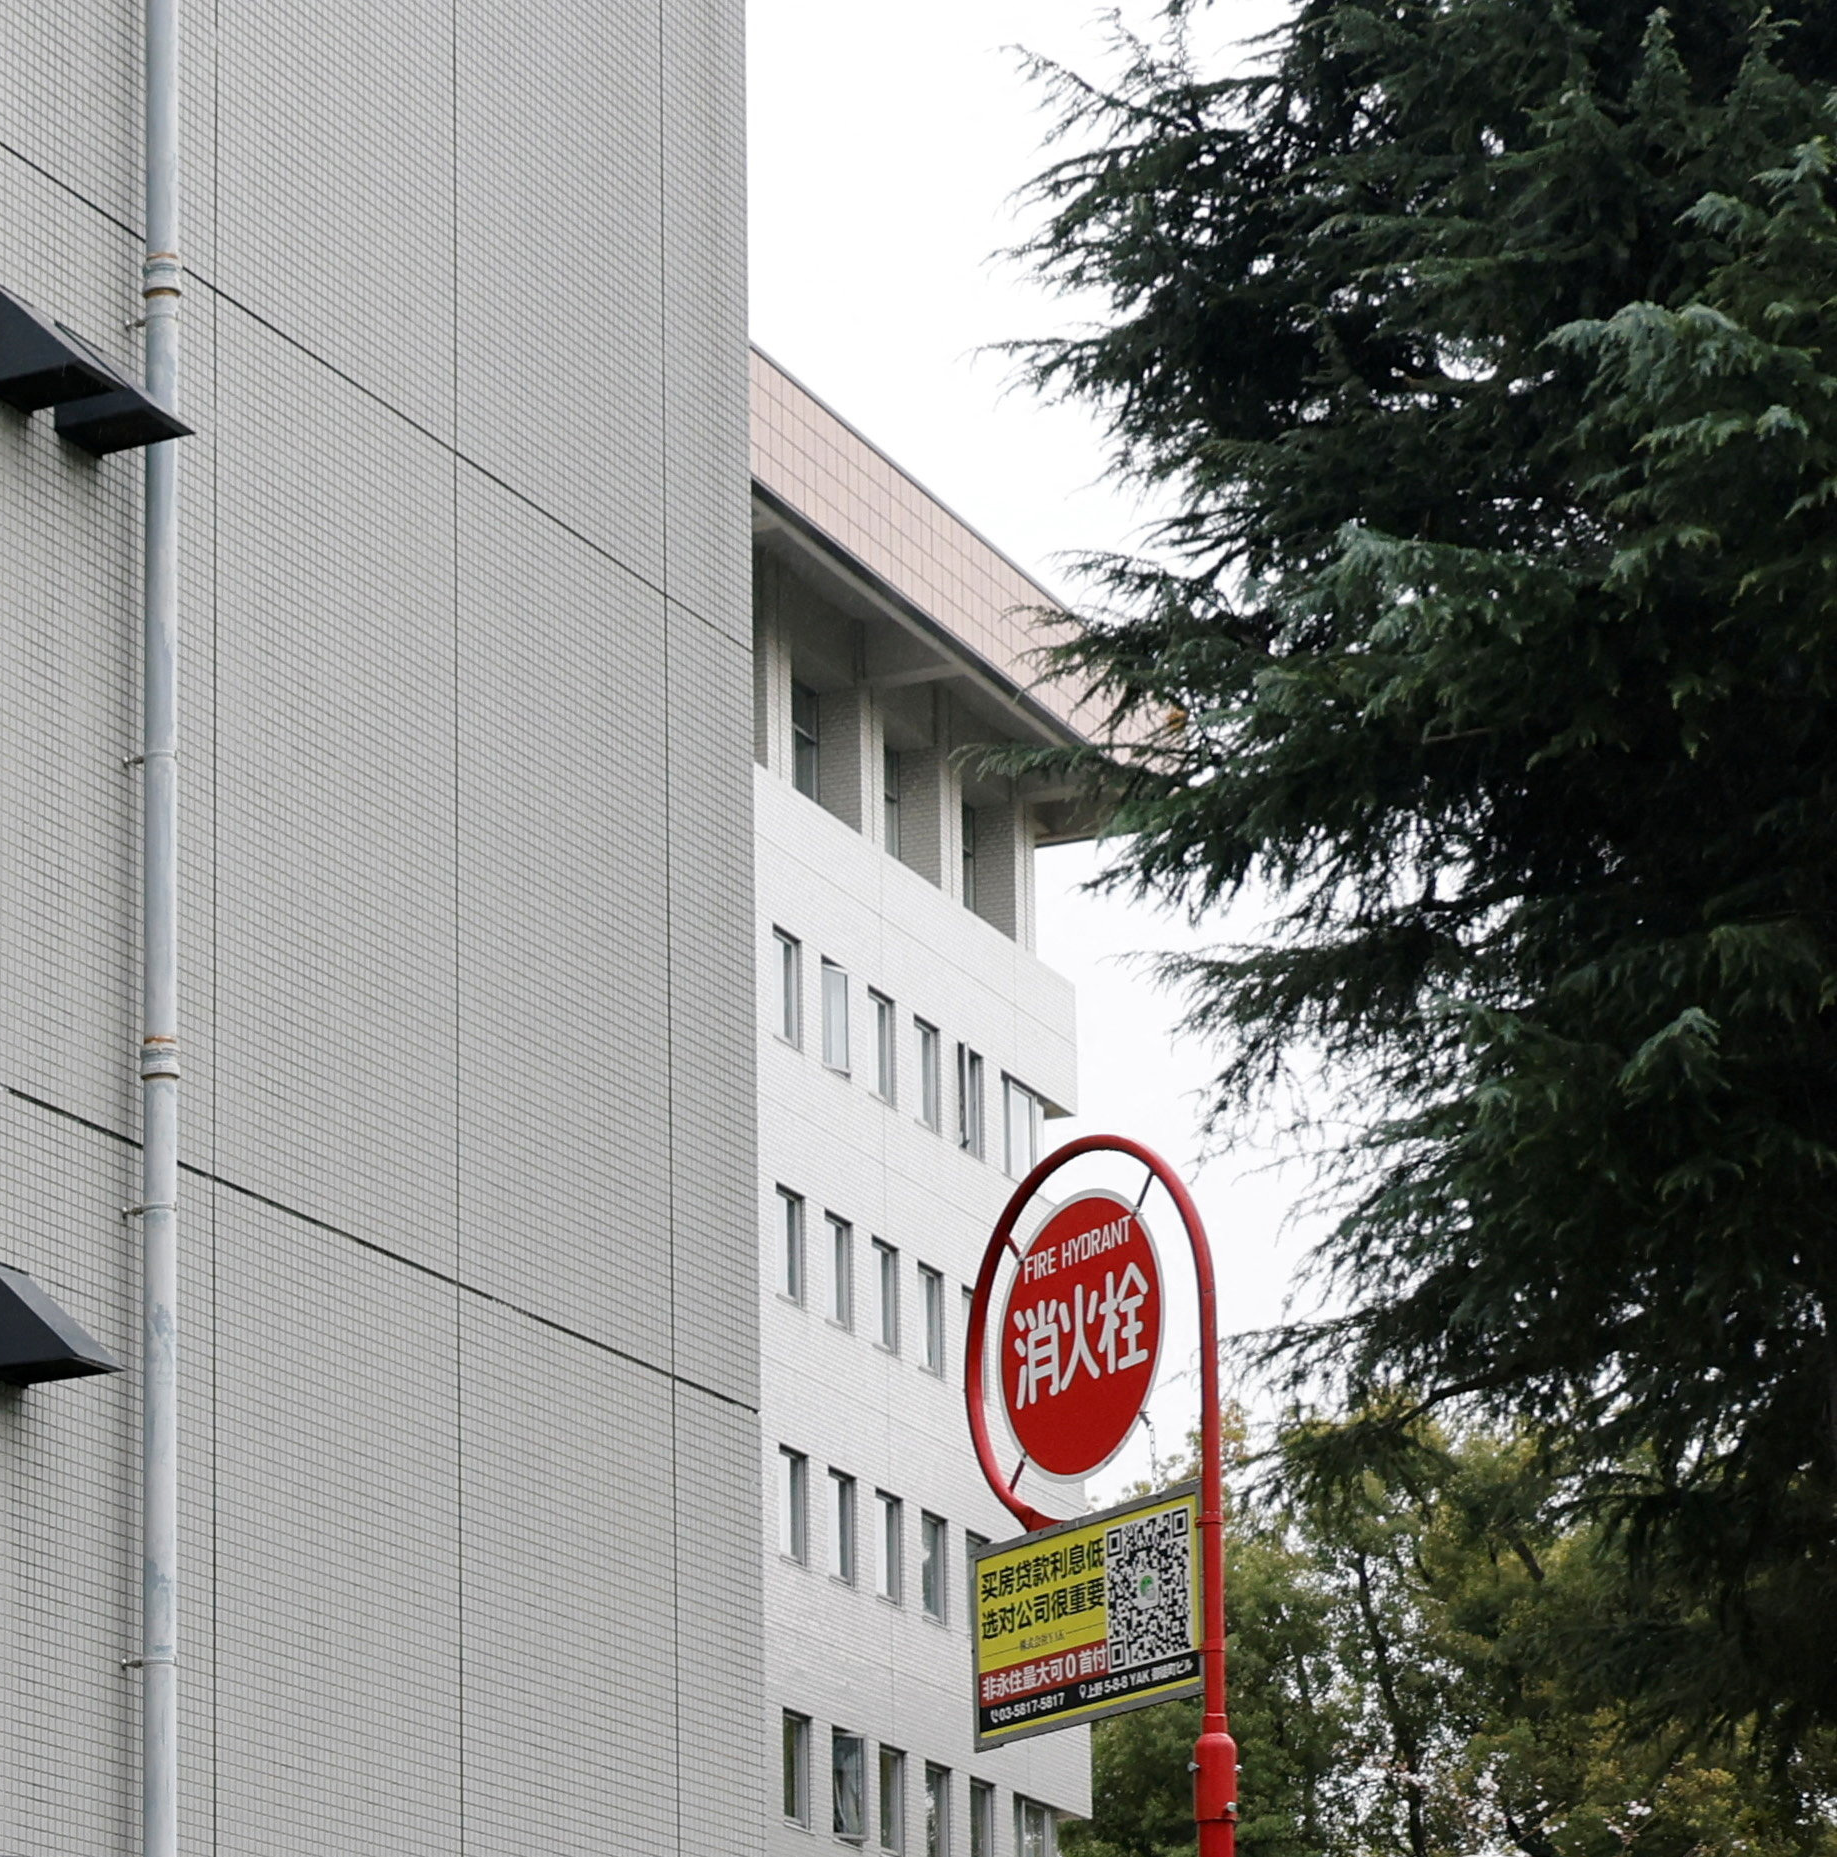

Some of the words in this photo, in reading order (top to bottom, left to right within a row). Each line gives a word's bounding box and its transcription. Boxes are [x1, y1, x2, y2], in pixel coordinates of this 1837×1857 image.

[1024, 1247, 1057, 1284] FIRE
[1061, 1215, 1132, 1269] HYDRANT
[1013, 1262, 1149, 1410] 消火栓
[981, 1537, 1104, 1602] 买房贷款利息低
[981, 1577, 1105, 1640] 选对公司很重要
